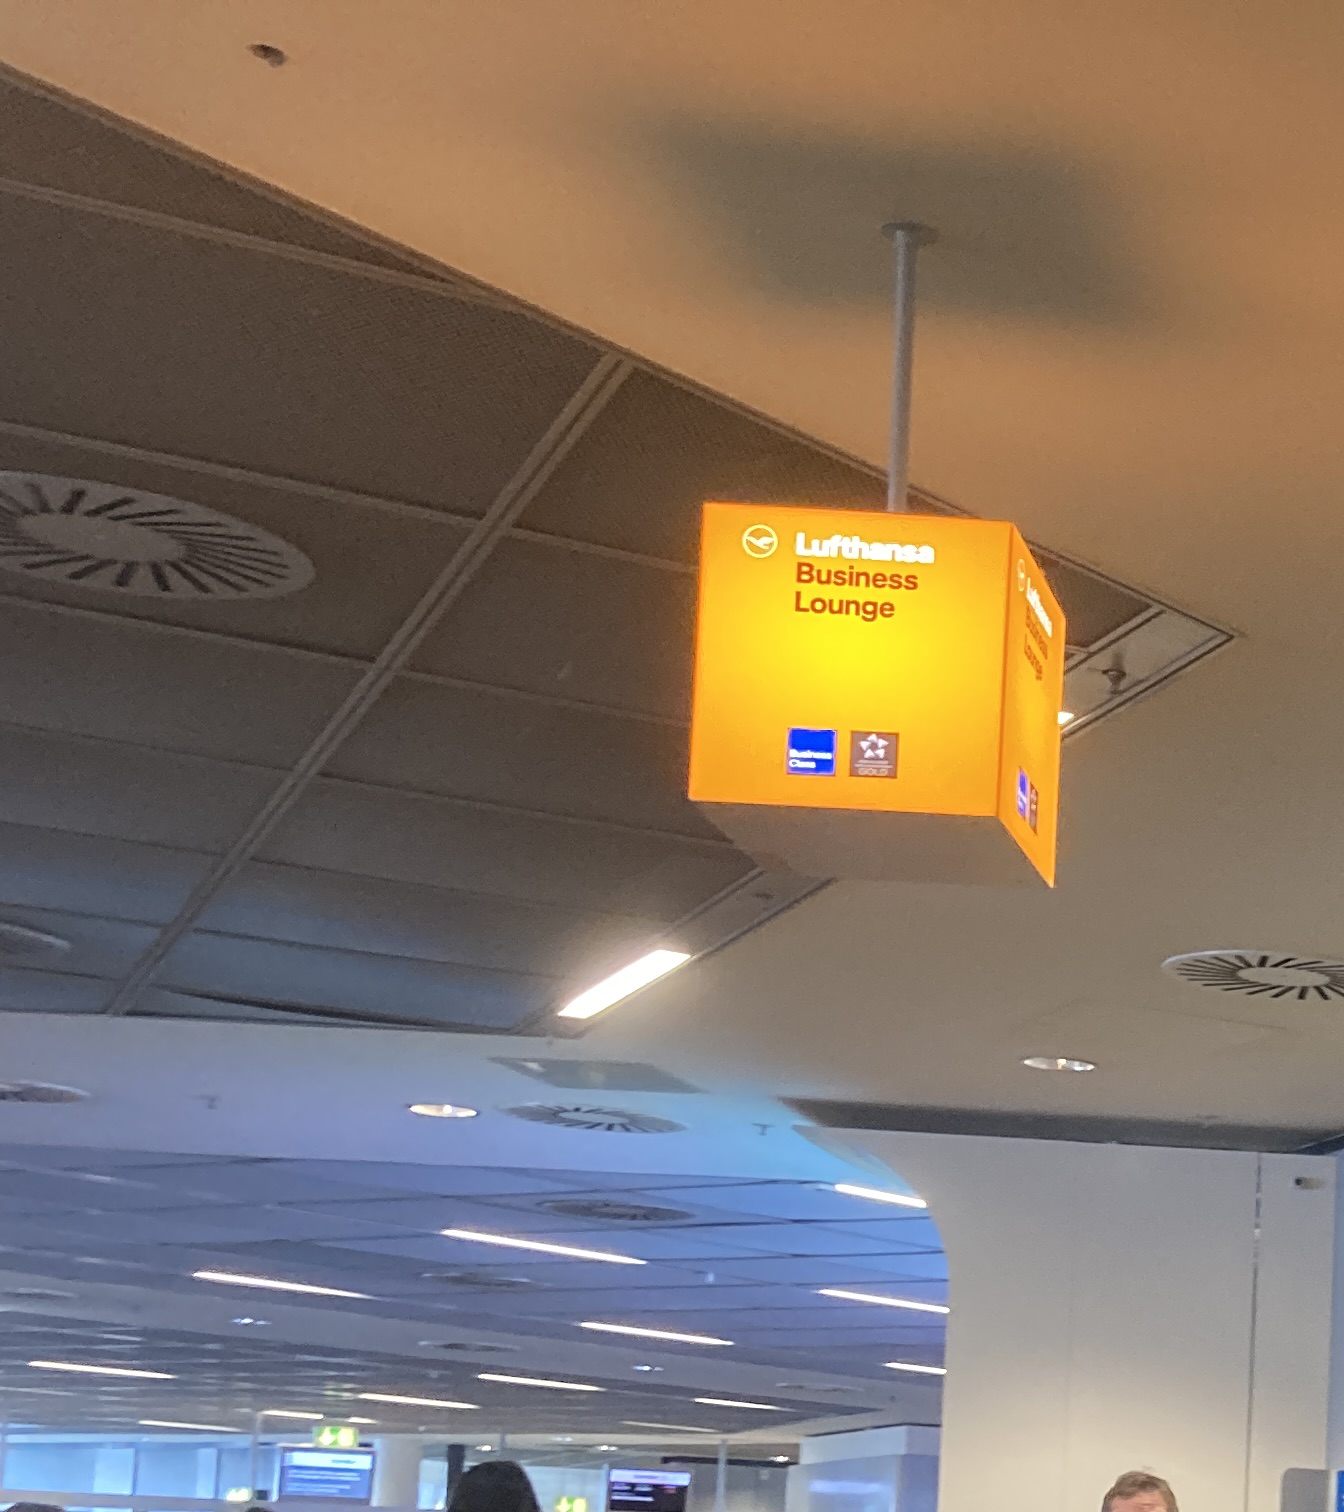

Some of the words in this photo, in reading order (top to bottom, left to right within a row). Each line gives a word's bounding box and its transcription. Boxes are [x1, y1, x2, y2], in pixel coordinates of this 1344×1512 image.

[795, 532, 935, 563] Lufthansa
[796, 562, 919, 590] Business
[795, 591, 895, 622] Lounge
